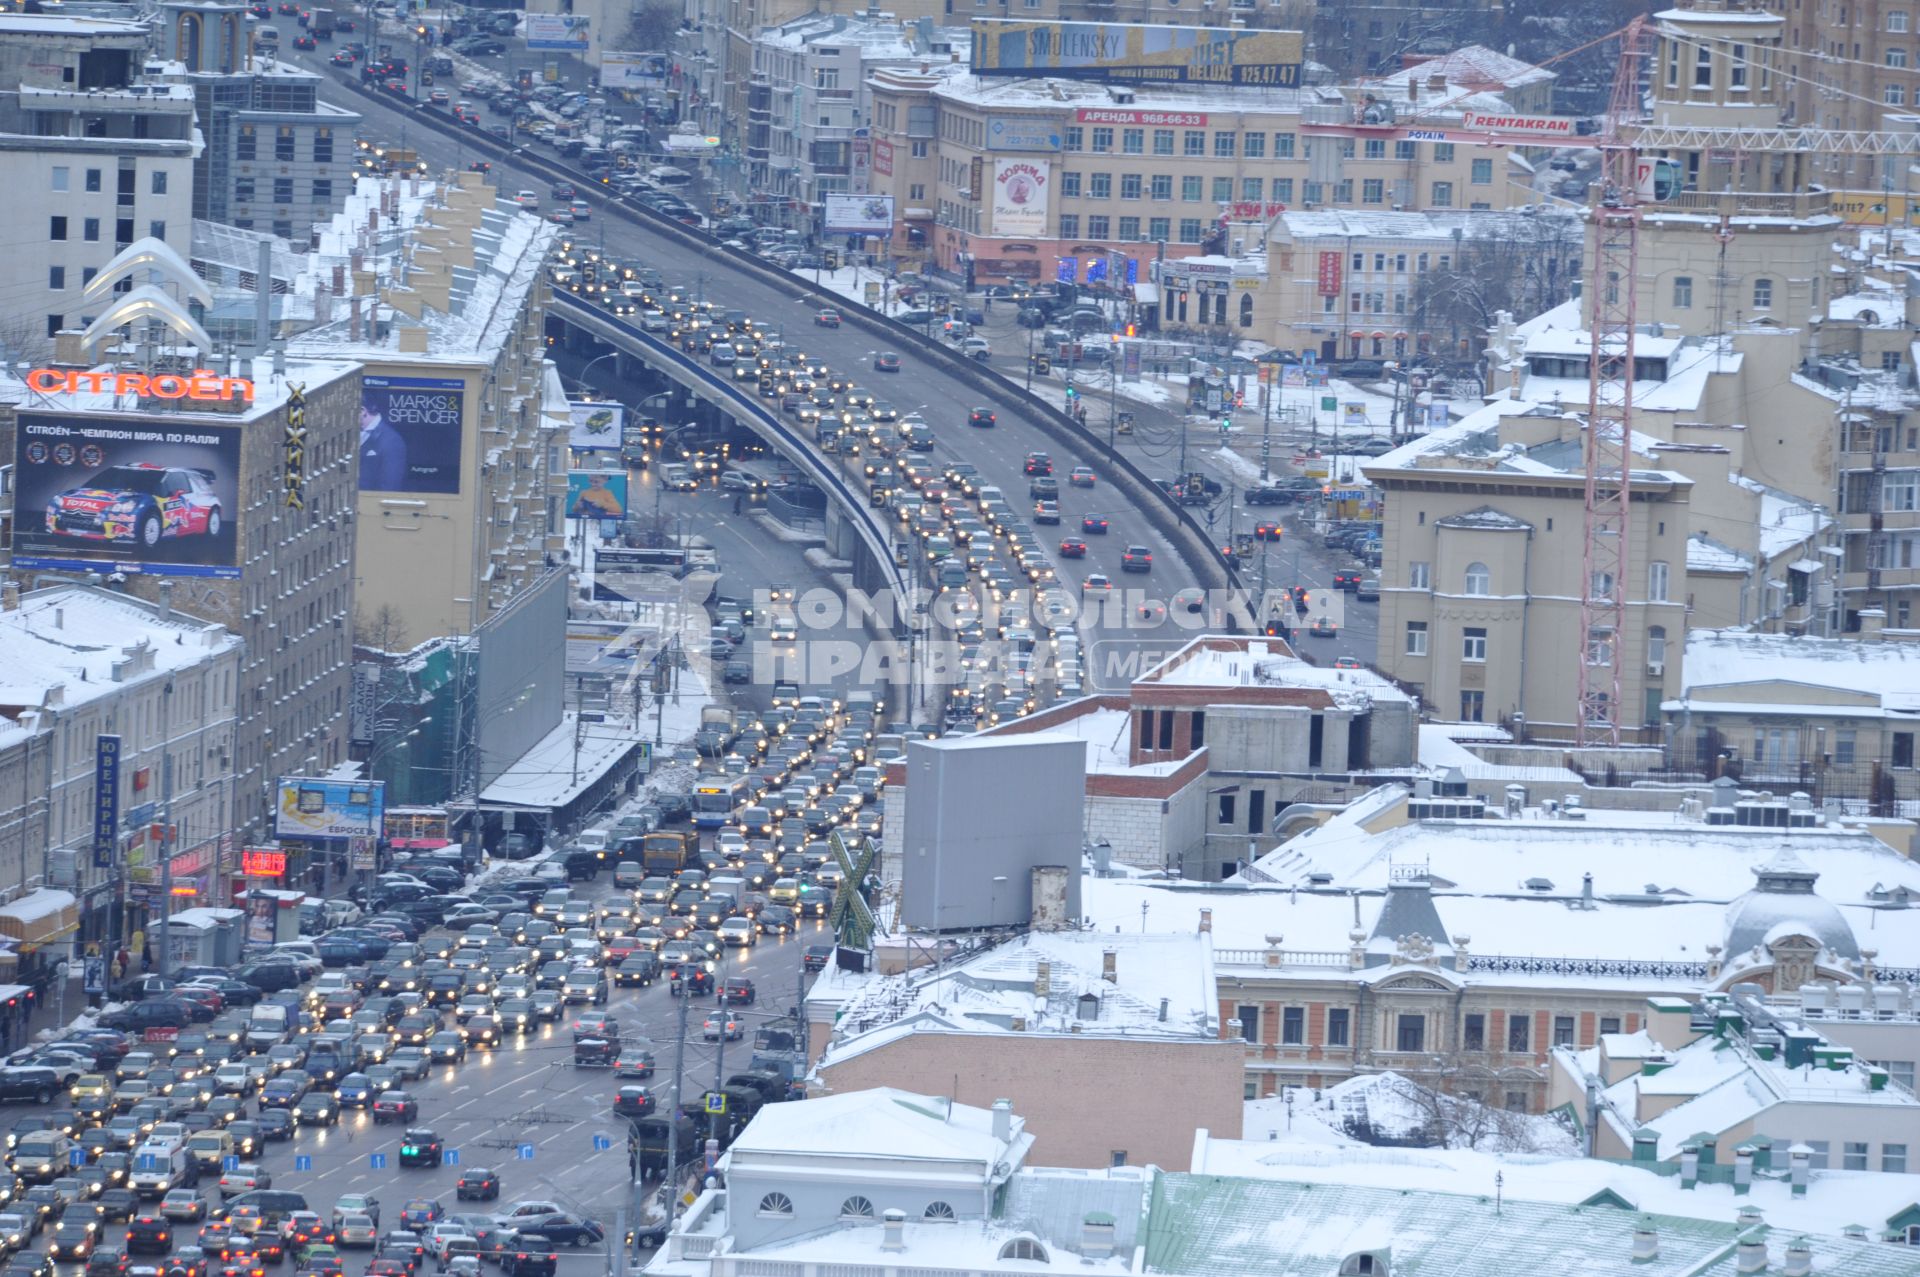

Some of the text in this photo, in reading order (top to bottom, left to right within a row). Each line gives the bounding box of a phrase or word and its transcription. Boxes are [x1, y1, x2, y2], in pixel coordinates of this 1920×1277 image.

[1028, 31, 1120, 58] SMOLENSKY
[1189, 39, 1237, 65] JUST
[1187, 64, 1234, 82] DELUXE
[1084, 111, 1201, 125] АРЕНДА 968-66-33
[1475, 116, 1568, 131] RENTAKRAN
[1408, 130, 1446, 141] POTAIN
[997, 163, 1046, 186] КОРЧМА
[826, 252, 836, 267] 5
[583, 266, 595, 282] 5
[1038, 355, 1049, 372] 5
[761, 373, 773, 389] 5
[388, 408, 459, 424] SPENCER
[134, 431, 164, 442] МИРА
[166, 433, 182, 443] ПО
[184, 434, 220, 445] РАЛЛИ
[285, 380, 306, 510] ХИЖИНА
[66, 498, 100, 510] TOTAL
[872, 490, 885, 505] 5
[357, 672, 366, 714] САЛОН
[364, 683, 374, 739] КРАСОТЫ
[99, 742, 116, 862] ЮВЕЛИРНЫЙ
